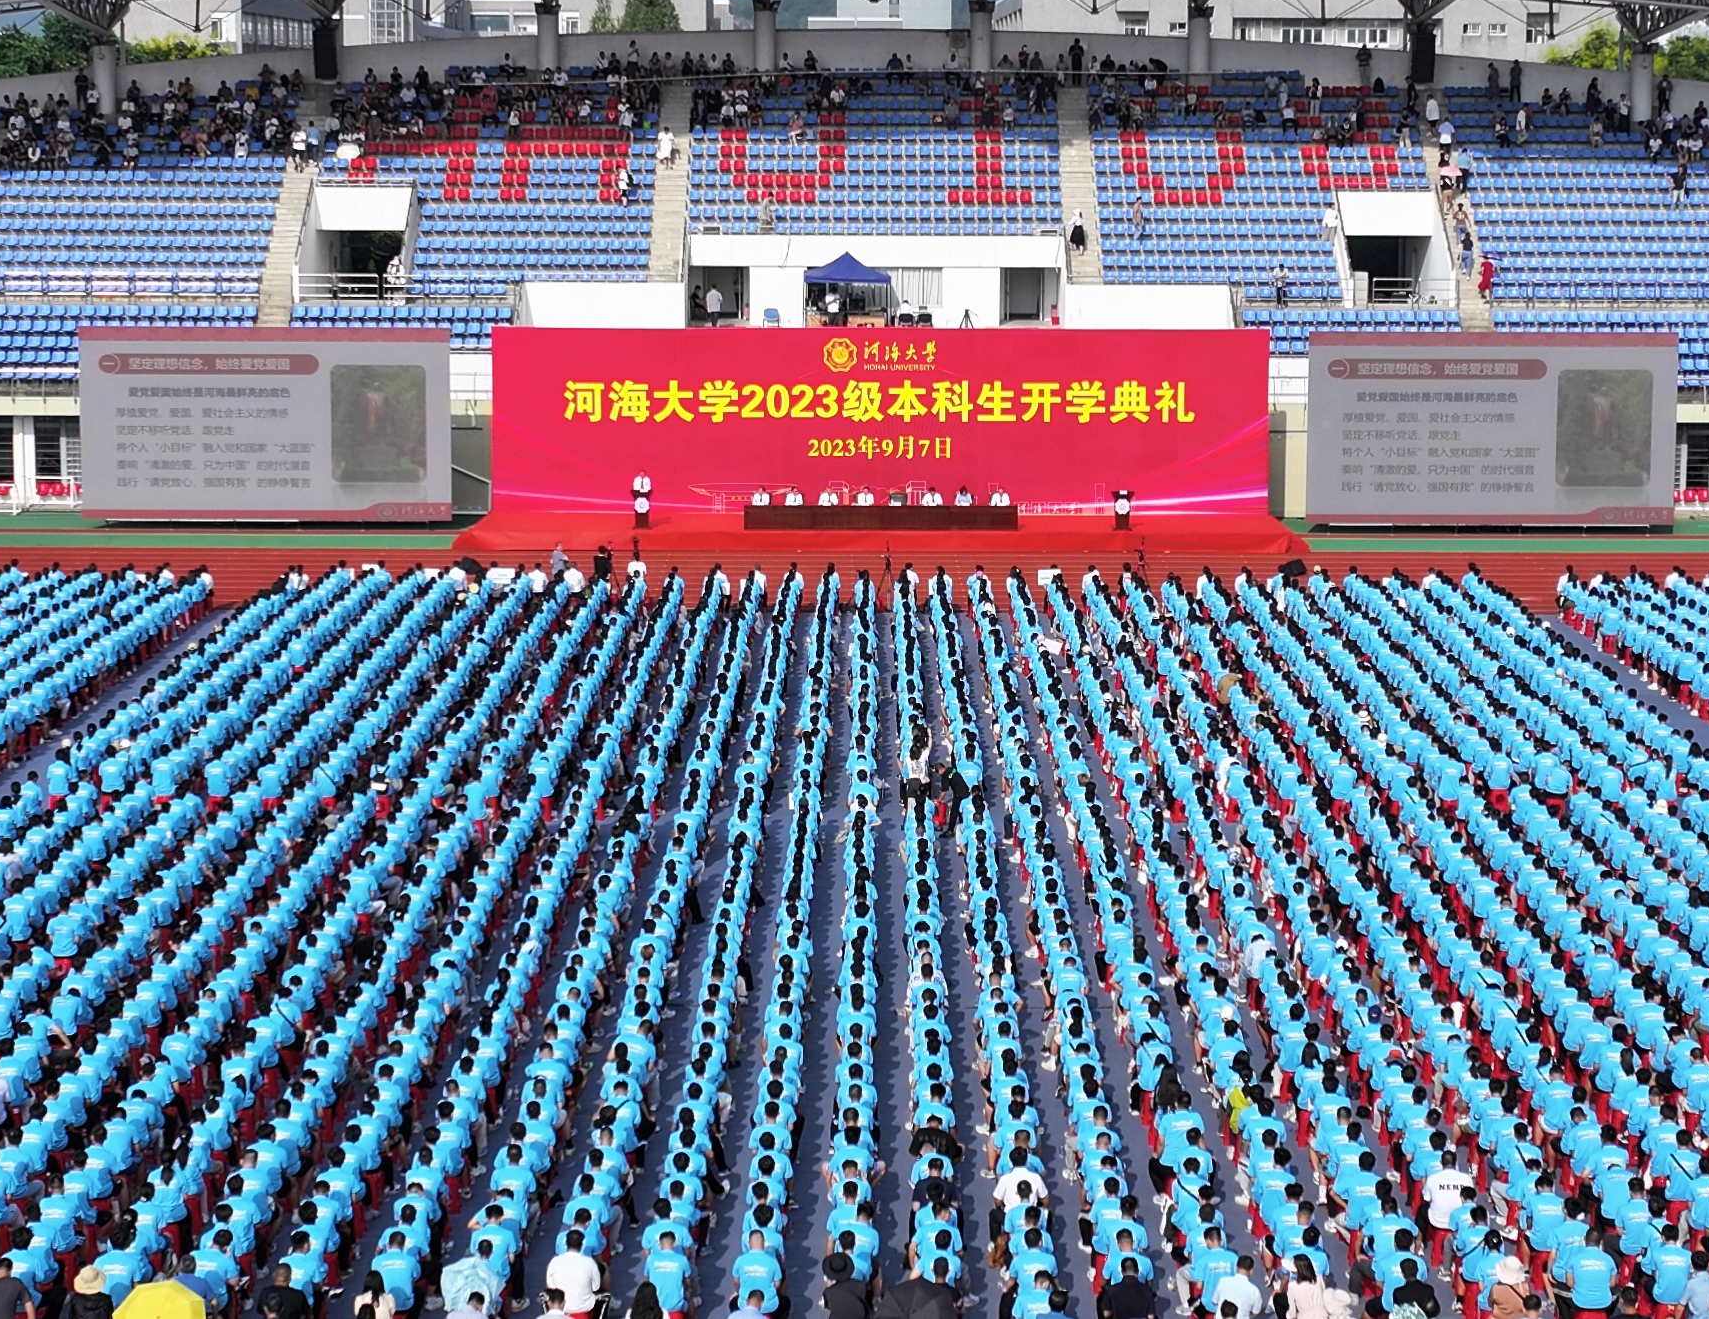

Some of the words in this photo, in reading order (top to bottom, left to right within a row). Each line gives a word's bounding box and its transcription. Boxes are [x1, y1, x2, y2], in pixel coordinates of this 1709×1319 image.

[863, 339, 937, 363] 河海大学
[563, 379, 1196, 424] 河海大学2023级本科生开学典礼
[807, 435, 952, 460] 2023年9月7日
